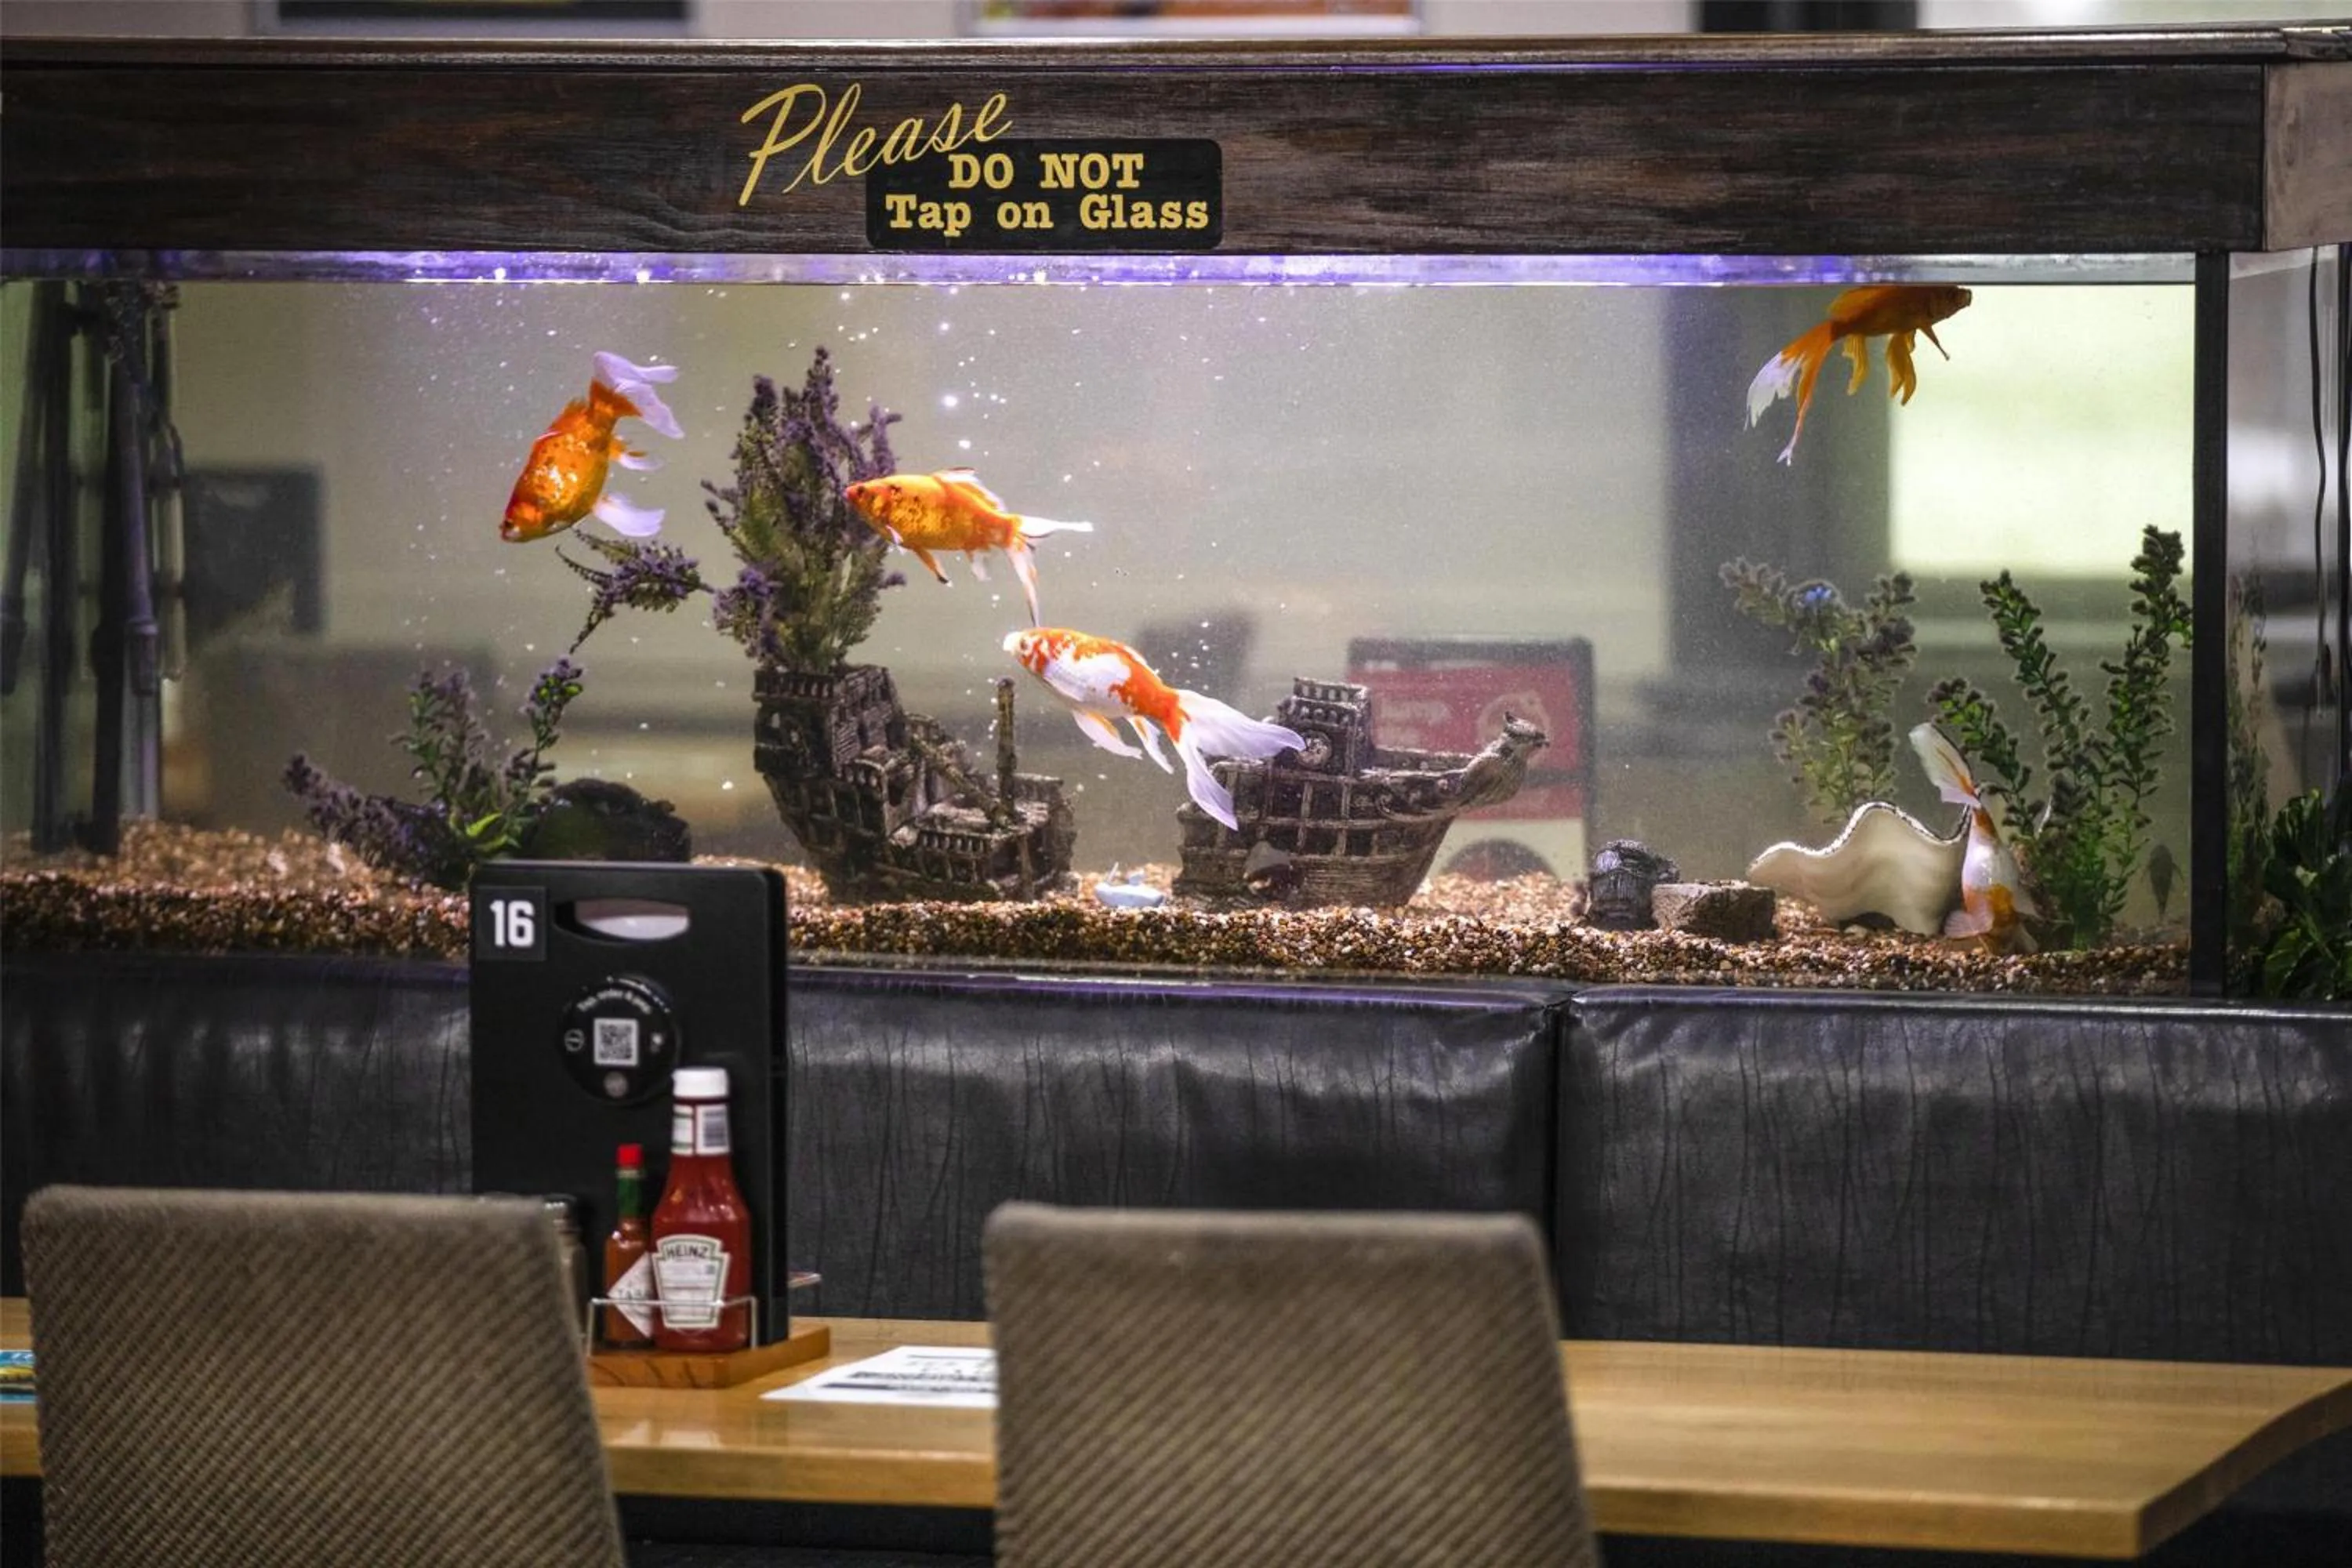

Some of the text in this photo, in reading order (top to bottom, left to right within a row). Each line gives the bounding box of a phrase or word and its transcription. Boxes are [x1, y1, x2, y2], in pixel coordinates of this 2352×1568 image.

[739, 82, 1013, 206] Please
[948, 153, 1144, 189] DO NOT
[884, 193, 1208, 237] Tap on Glass
[489, 899, 535, 947] 16
[666, 1244, 709, 1259] HEINZ
